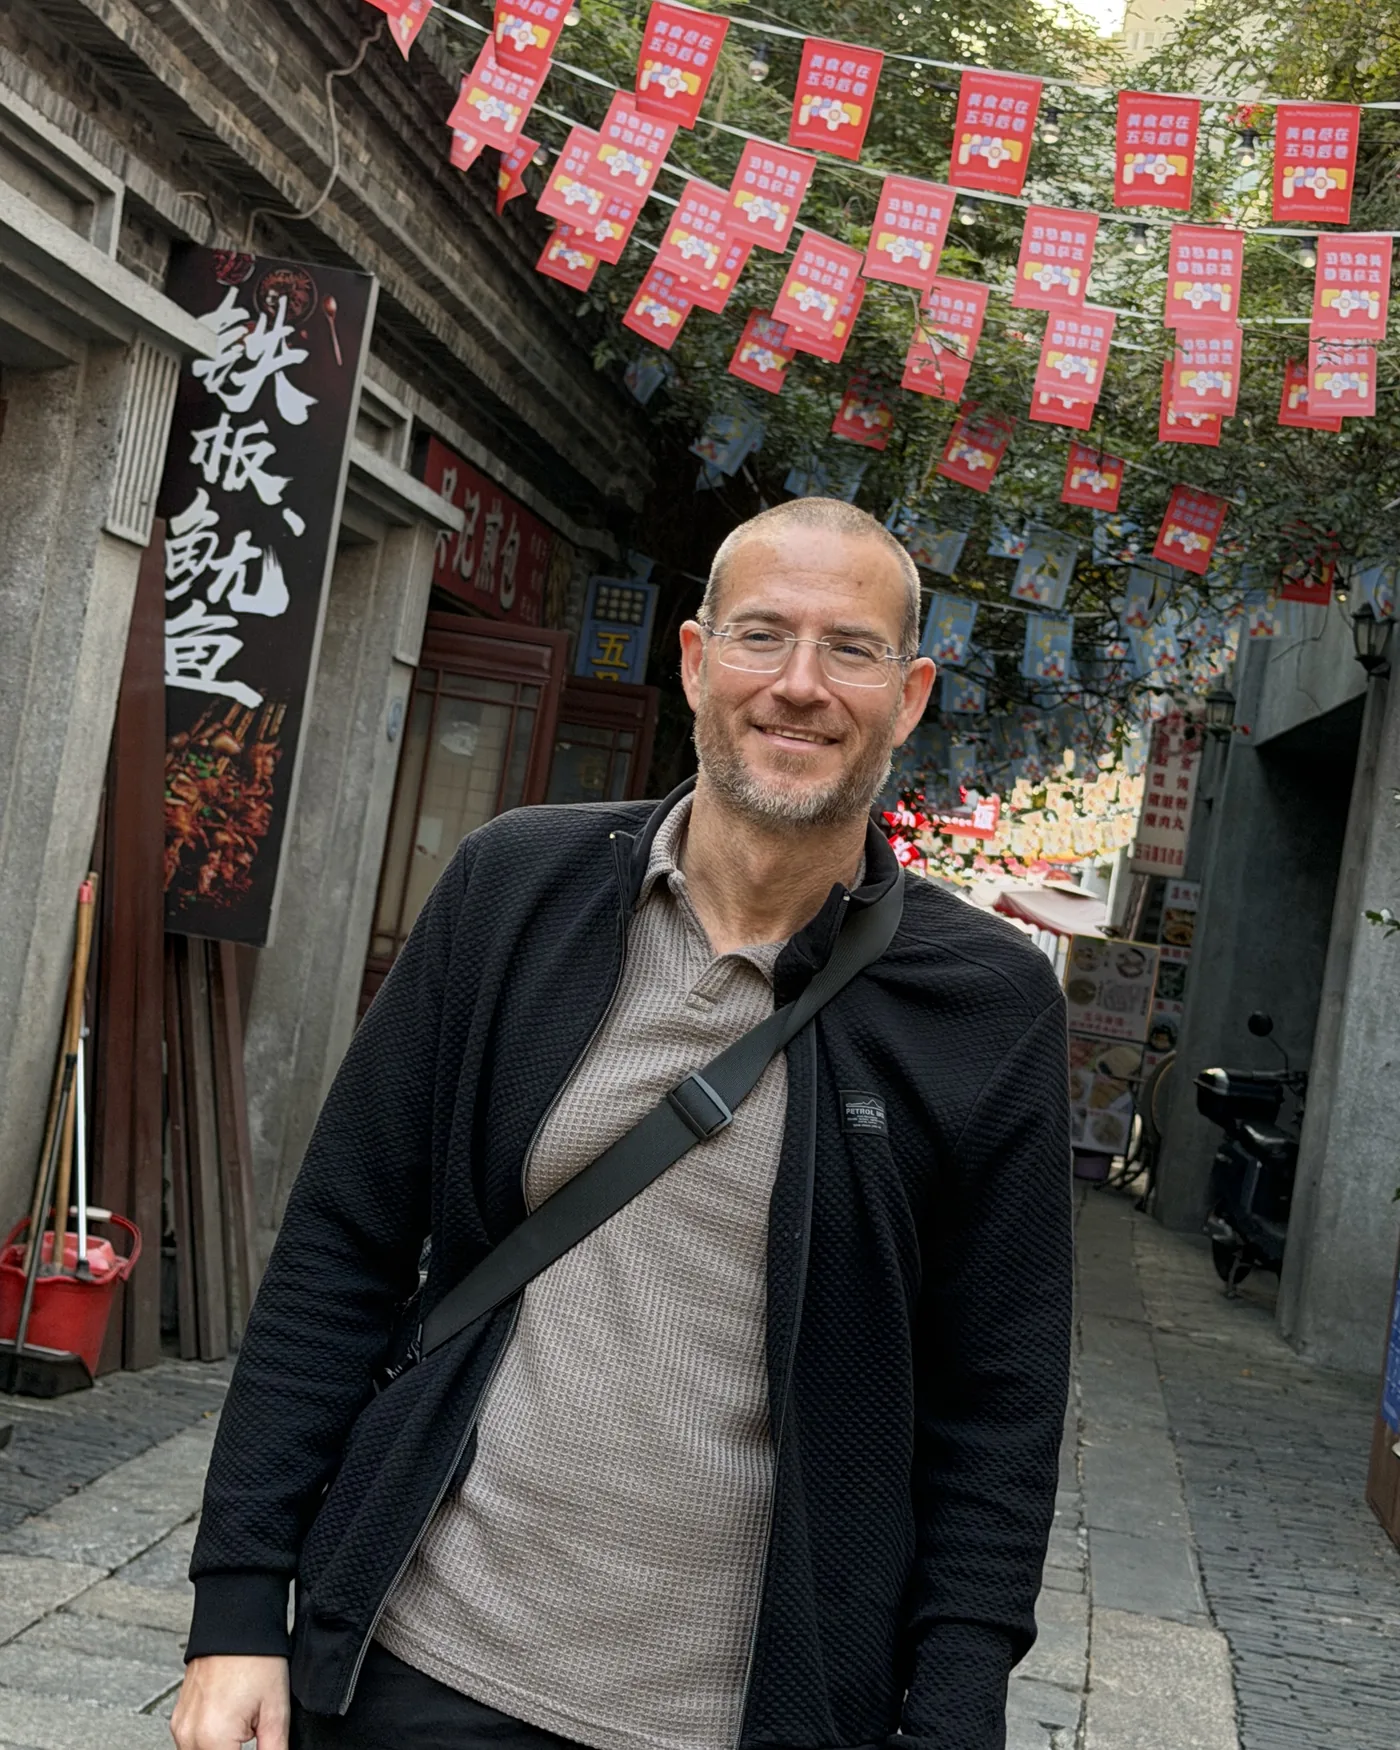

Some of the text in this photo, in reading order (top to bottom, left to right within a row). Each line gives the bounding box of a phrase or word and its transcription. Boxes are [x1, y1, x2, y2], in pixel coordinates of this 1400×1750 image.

[967, 92, 1030, 115] 美食尽在
[963, 109, 1027, 133] 五马后巷
[1125, 113, 1191, 130] 美食尽在
[1123, 130, 1189, 148] 五马后巷
[1285, 126, 1350, 142] 美食尽在
[1283, 143, 1349, 159] 五马后巷
[164, 286, 318, 708] 铁板鱿鱼
[591, 631, 631, 681] 五
[846, 1108, 875, 1116] PETROL
